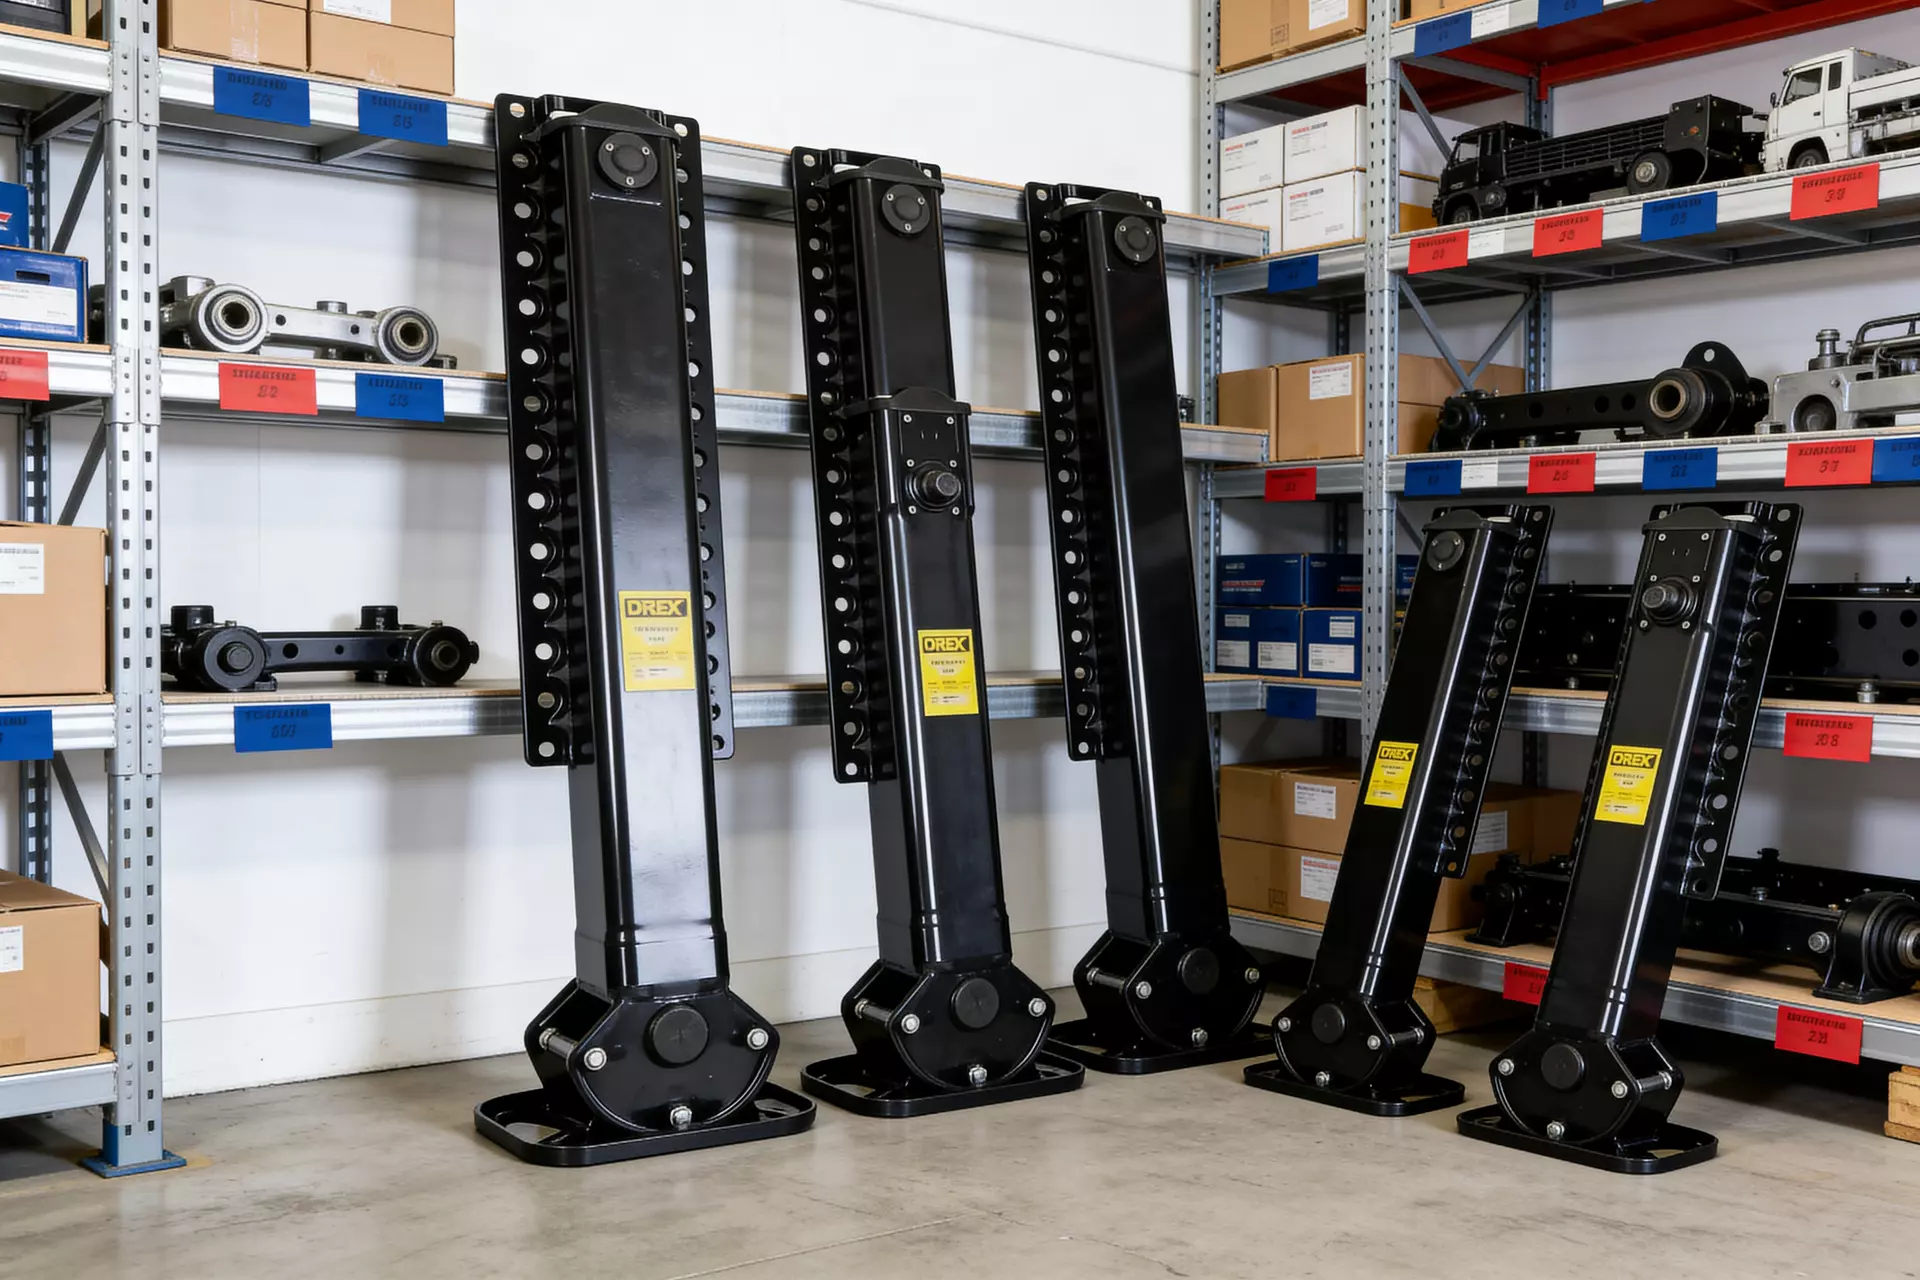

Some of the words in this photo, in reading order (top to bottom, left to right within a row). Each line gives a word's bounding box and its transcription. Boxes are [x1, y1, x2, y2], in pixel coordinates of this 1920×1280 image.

[627, 600, 684, 617] DREX
[924, 637, 968, 653] DREX
[1380, 748, 1413, 761] DREX
[1612, 753, 1655, 768] DREX
